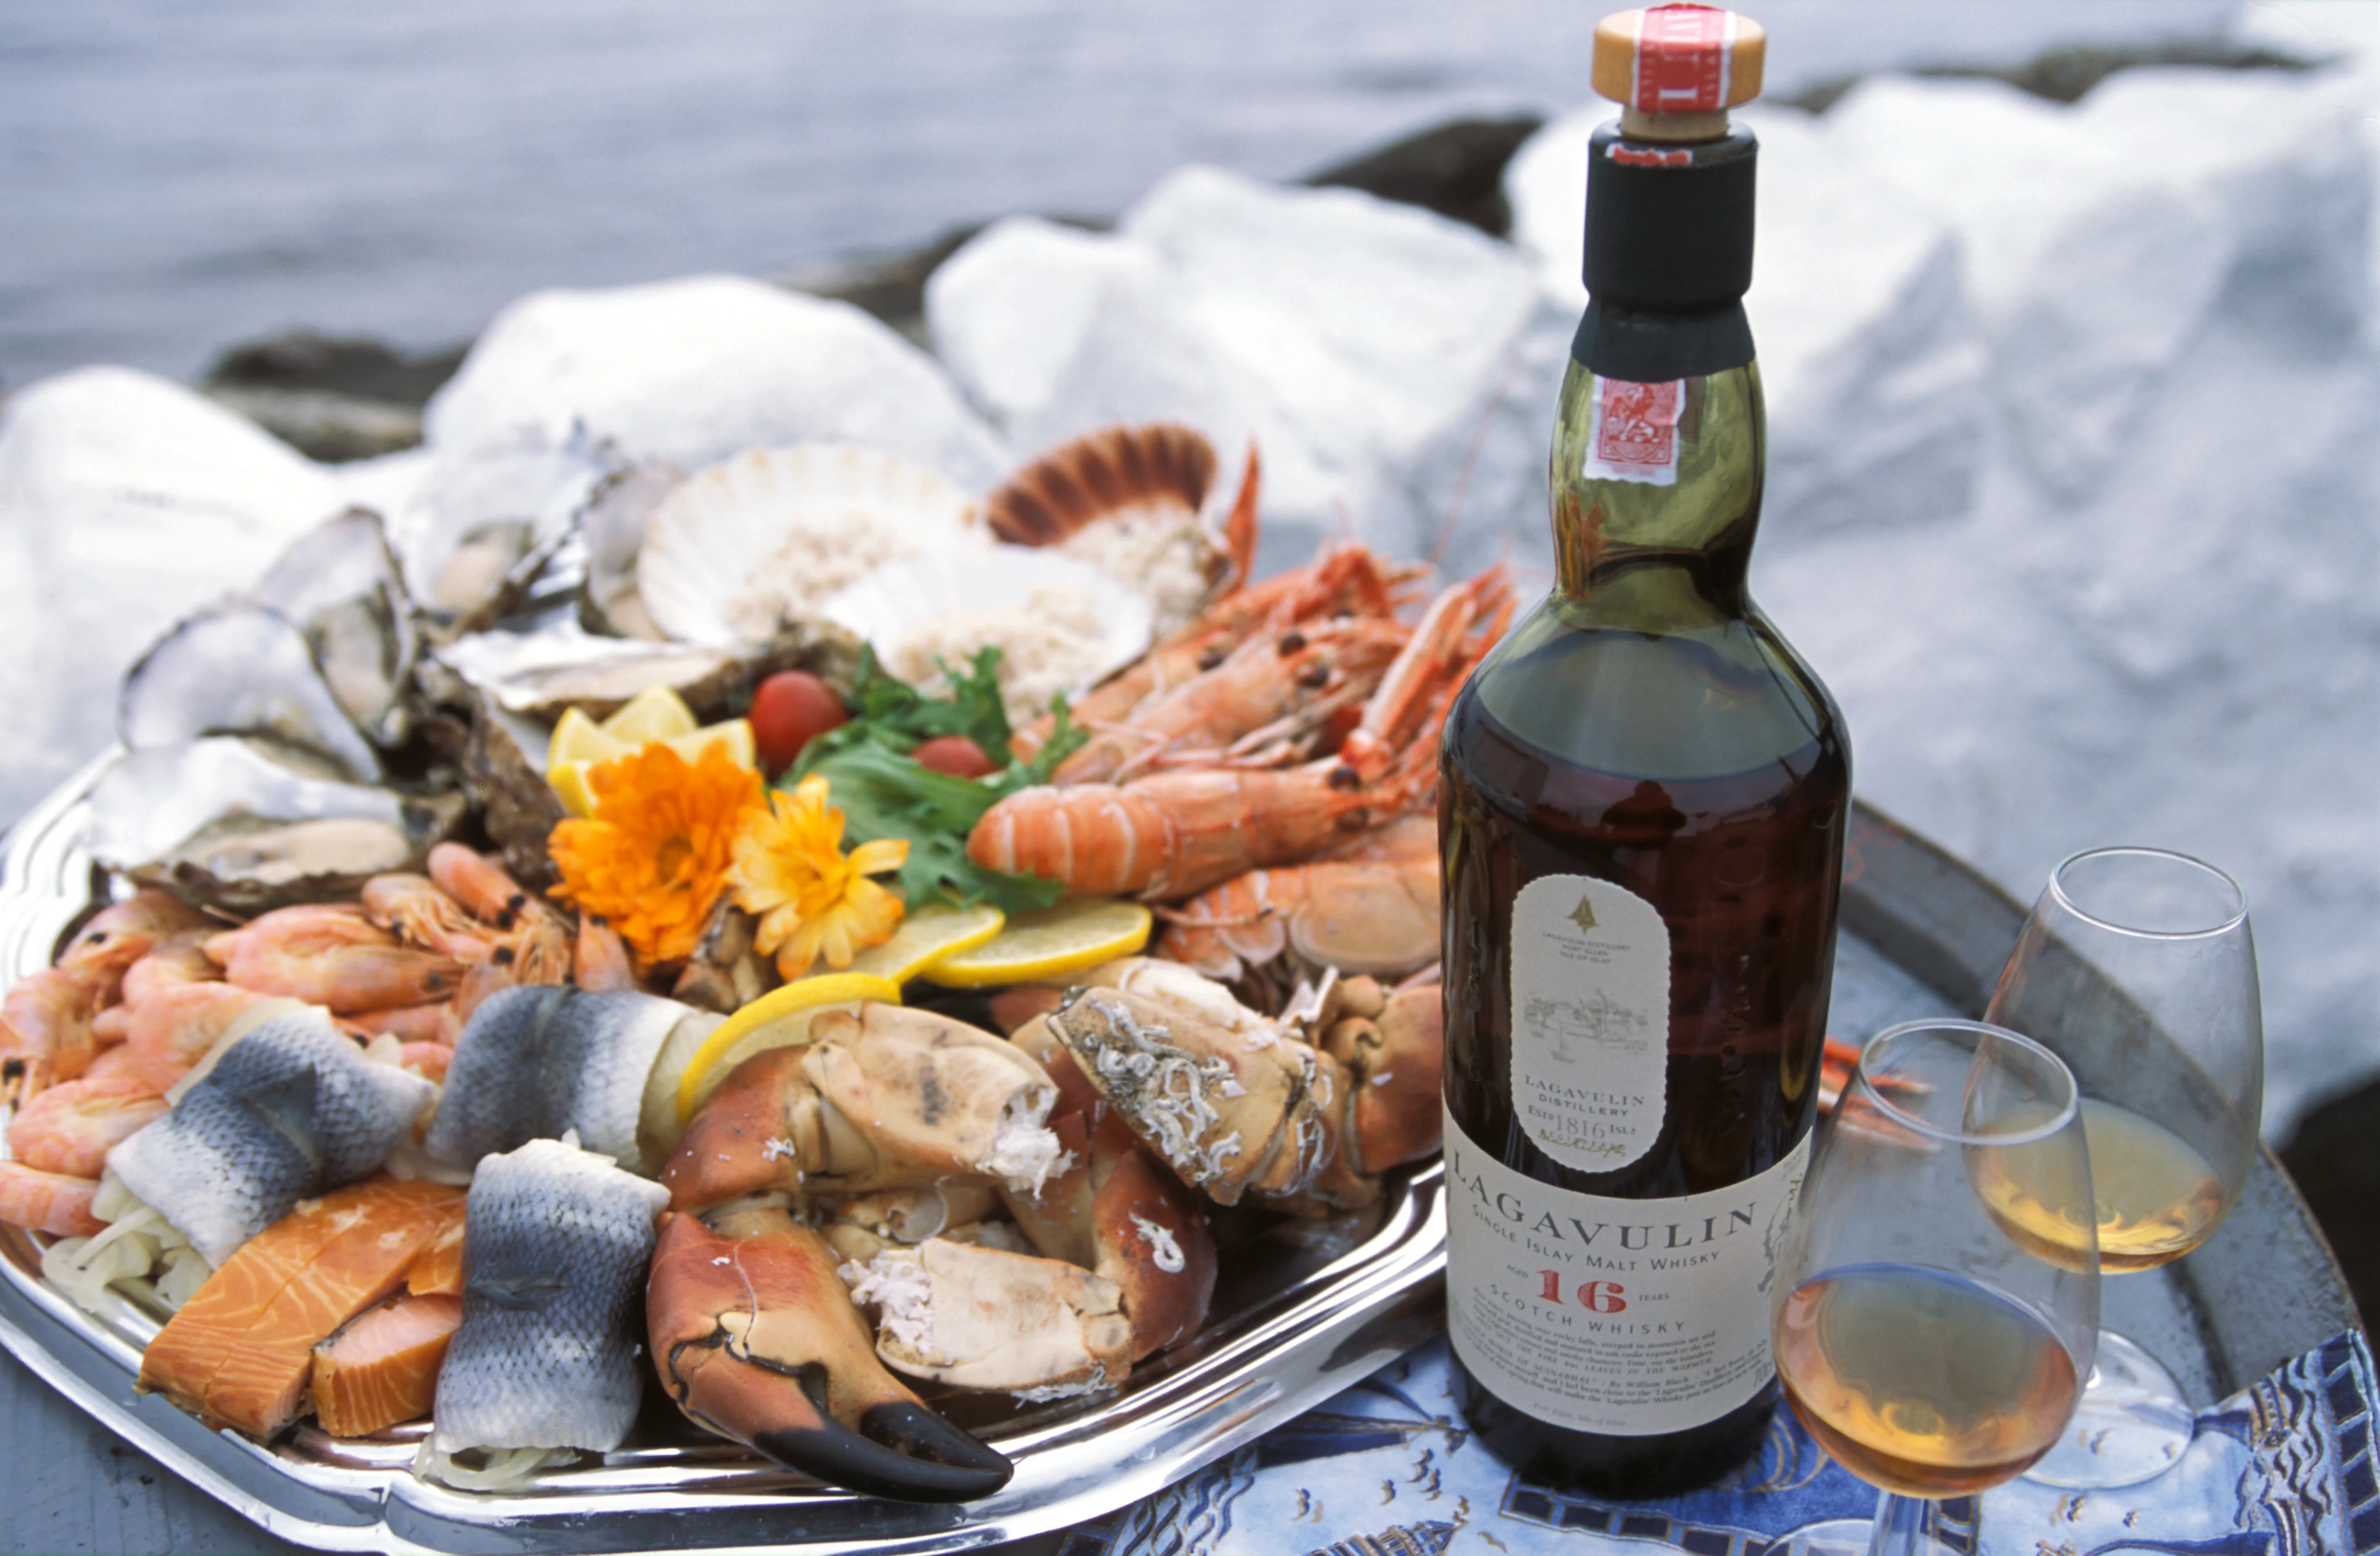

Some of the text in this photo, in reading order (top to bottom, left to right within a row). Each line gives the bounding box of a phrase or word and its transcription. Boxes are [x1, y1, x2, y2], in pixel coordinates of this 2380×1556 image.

[1524, 1074, 1645, 1107] LAGAVULIN
[1539, 1094, 1629, 1117] DISTILLERY
[1557, 1115, 1605, 1139] 1816
[1453, 1149, 1756, 1250] LAGAVULIN
[1473, 1204, 1719, 1270] SINGLE ISLAY MALT WHISKY
[1491, 1284, 1572, 1327] SCOTCH
[1588, 1321, 1685, 1334] WHISKY
[1506, 1264, 1670, 1314] AGED 16 YEARS
